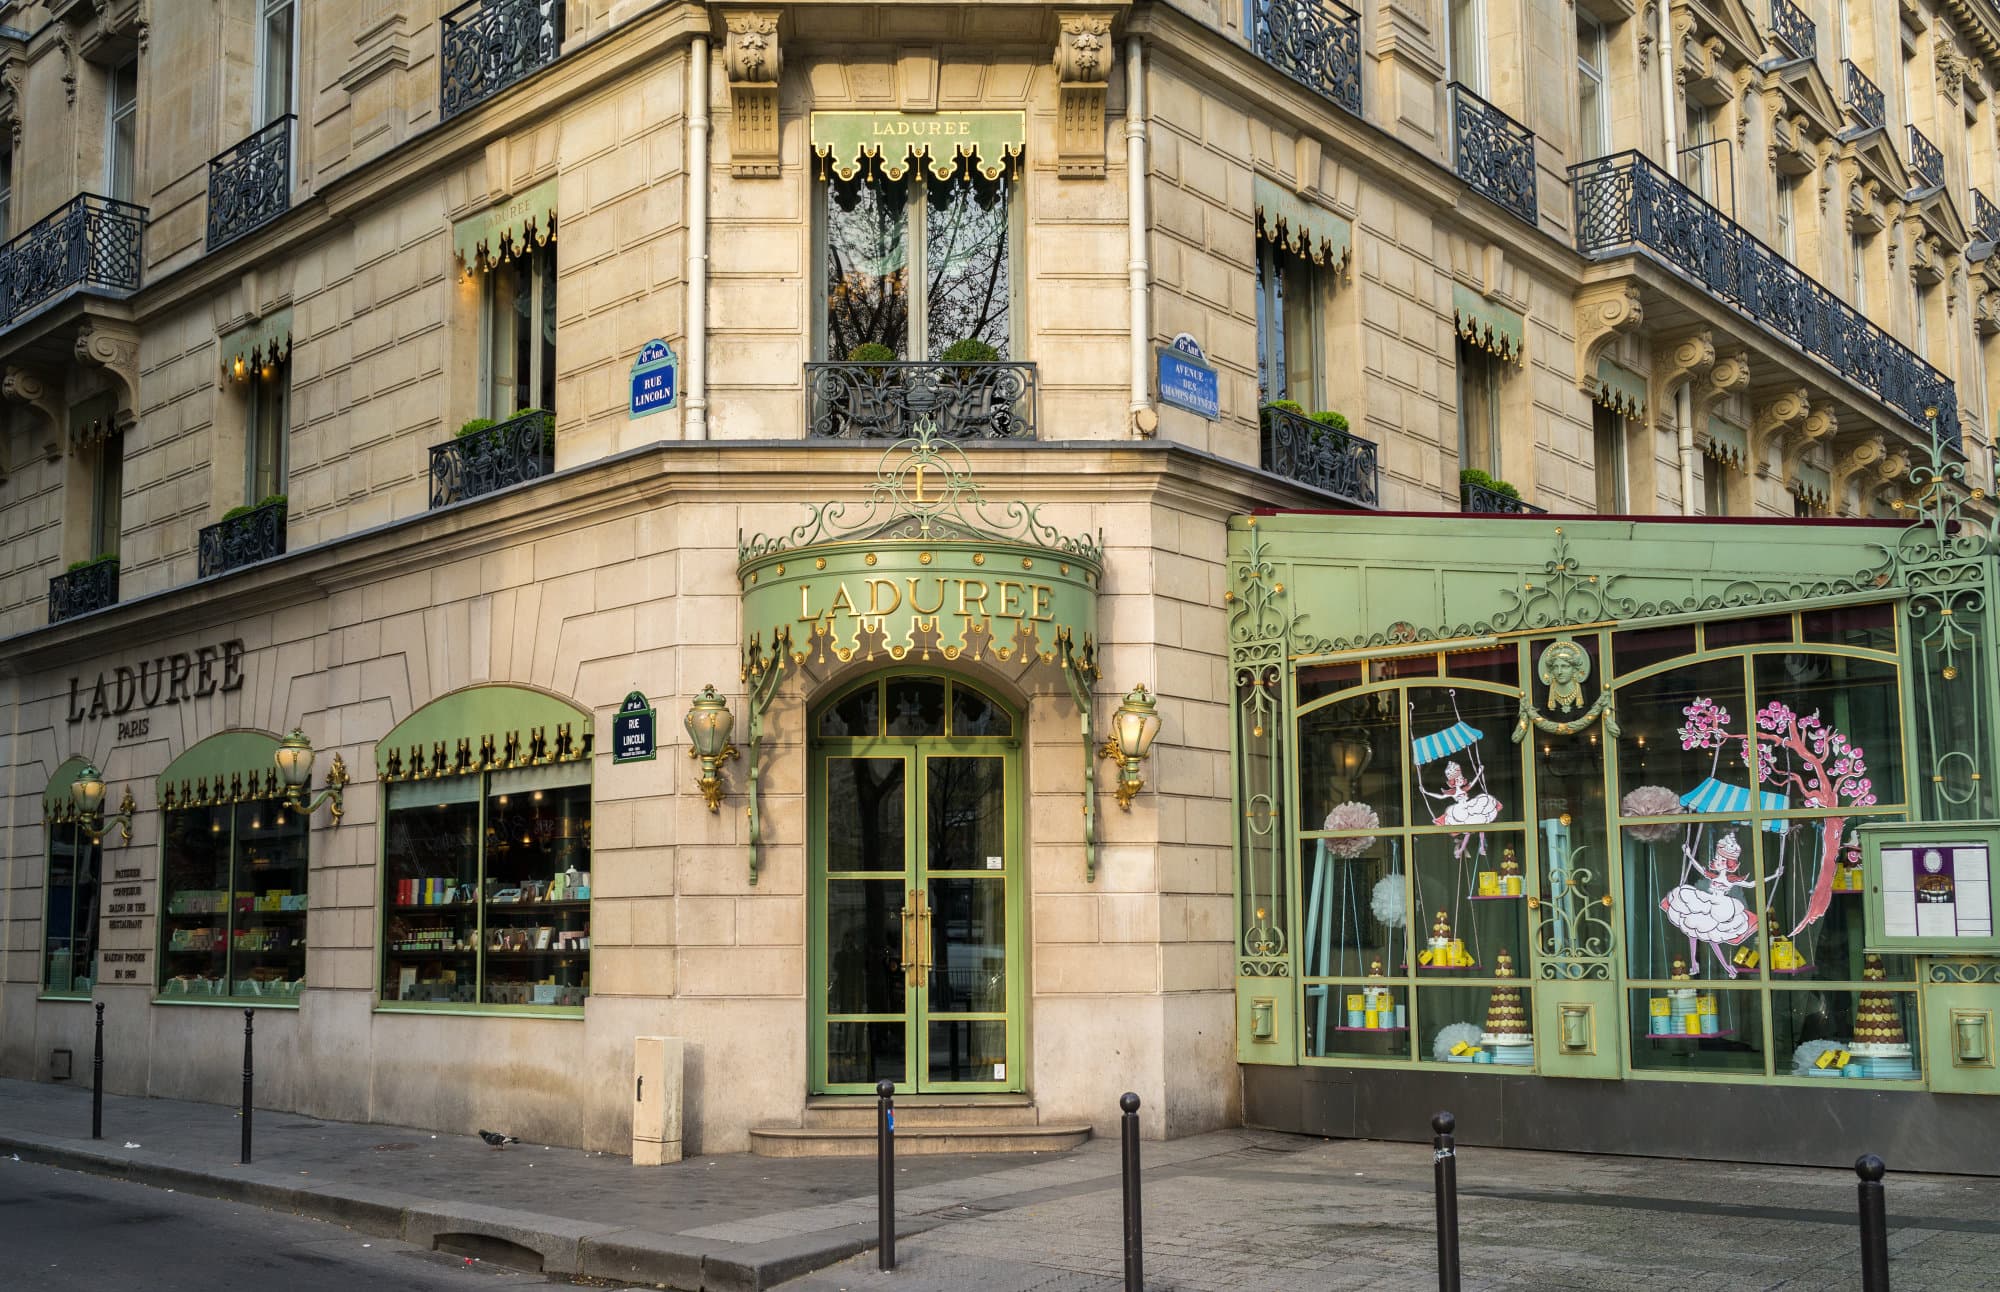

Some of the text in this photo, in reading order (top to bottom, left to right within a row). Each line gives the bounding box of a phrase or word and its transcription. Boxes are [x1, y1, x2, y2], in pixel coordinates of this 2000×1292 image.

[872, 121, 971, 135] LADUREE
[1175, 363, 1204, 382] AVENUE
[644, 375, 662, 390] RUE
[1182, 379, 1197, 391] DES
[635, 386, 671, 407] LINCOLN
[909, 463, 944, 503] L
[798, 576, 1055, 622] LADUREE
[65, 637, 246, 723] LADUREE
[117, 717, 150, 740] PARIS
[628, 718, 640, 730] RUE
[623, 733, 645, 746] LINCOLN
